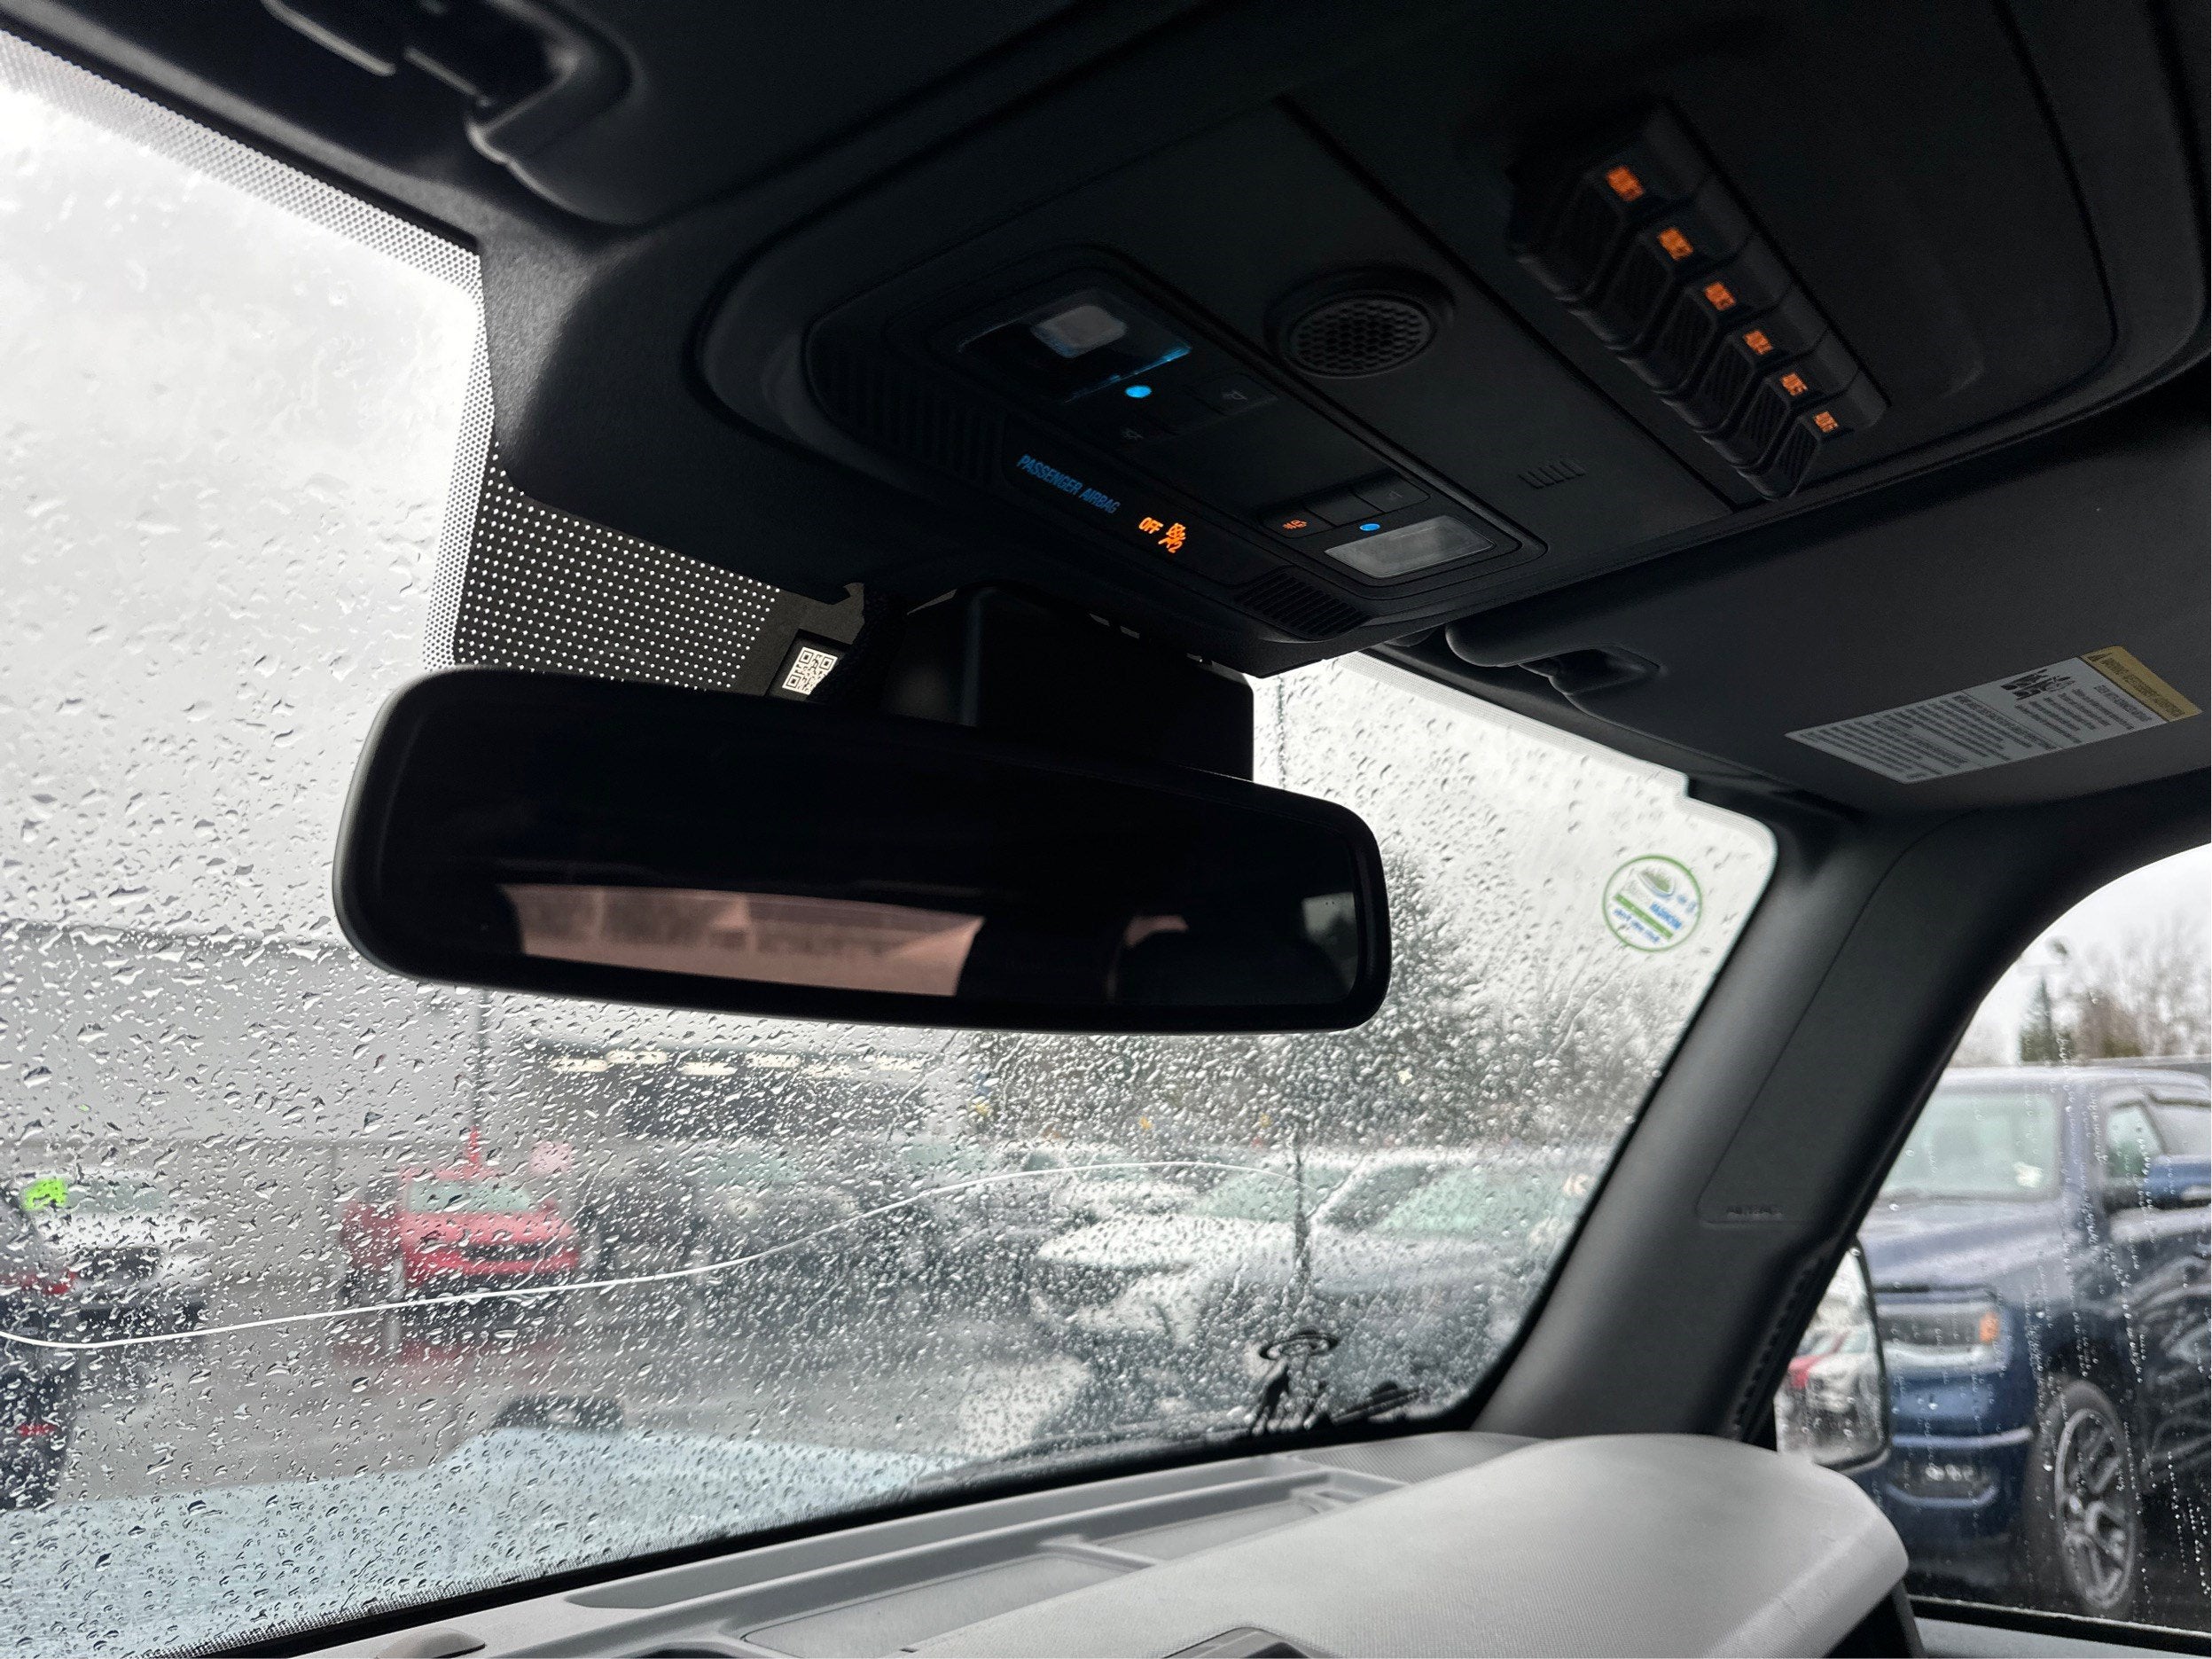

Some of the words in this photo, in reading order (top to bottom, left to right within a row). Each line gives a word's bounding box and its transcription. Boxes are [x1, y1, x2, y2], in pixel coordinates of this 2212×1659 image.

[1016, 453, 1083, 496] PASSENGER
[1079, 488, 1122, 514] AIRBAG
[1138, 516, 1164, 535] OFF
